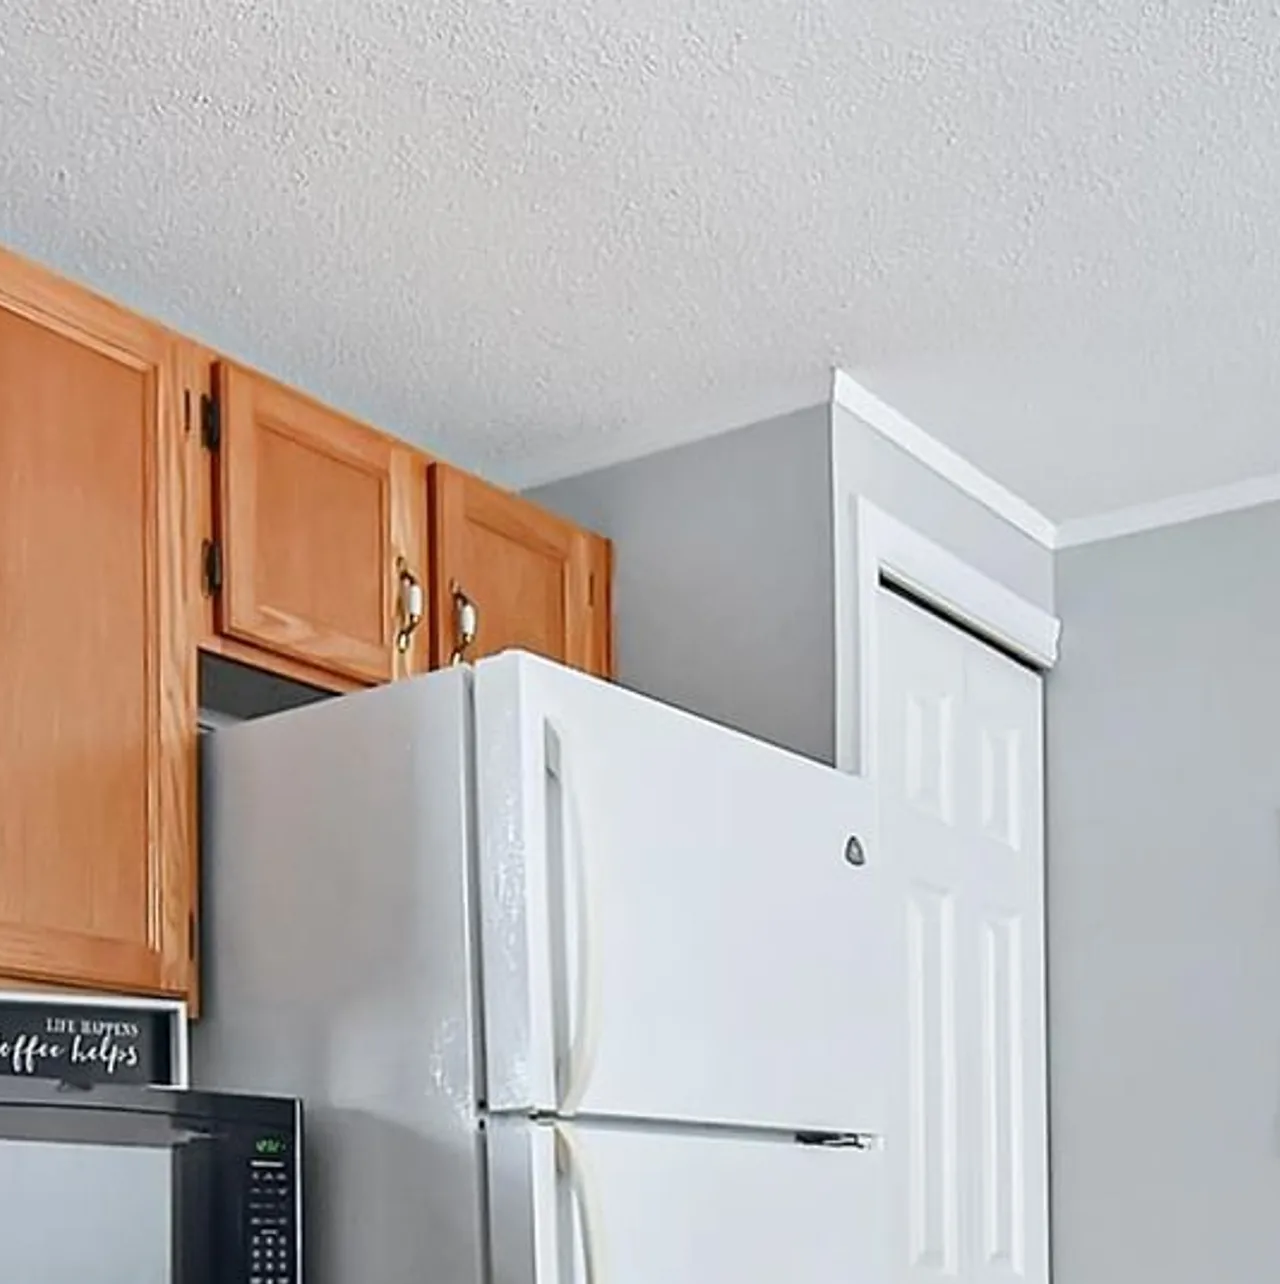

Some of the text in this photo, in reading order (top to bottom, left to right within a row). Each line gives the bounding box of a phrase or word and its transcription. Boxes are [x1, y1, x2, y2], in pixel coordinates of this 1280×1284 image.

[46, 1017, 139, 1037] LIFE HAPPENS
[71, 1034, 138, 1074] helps
